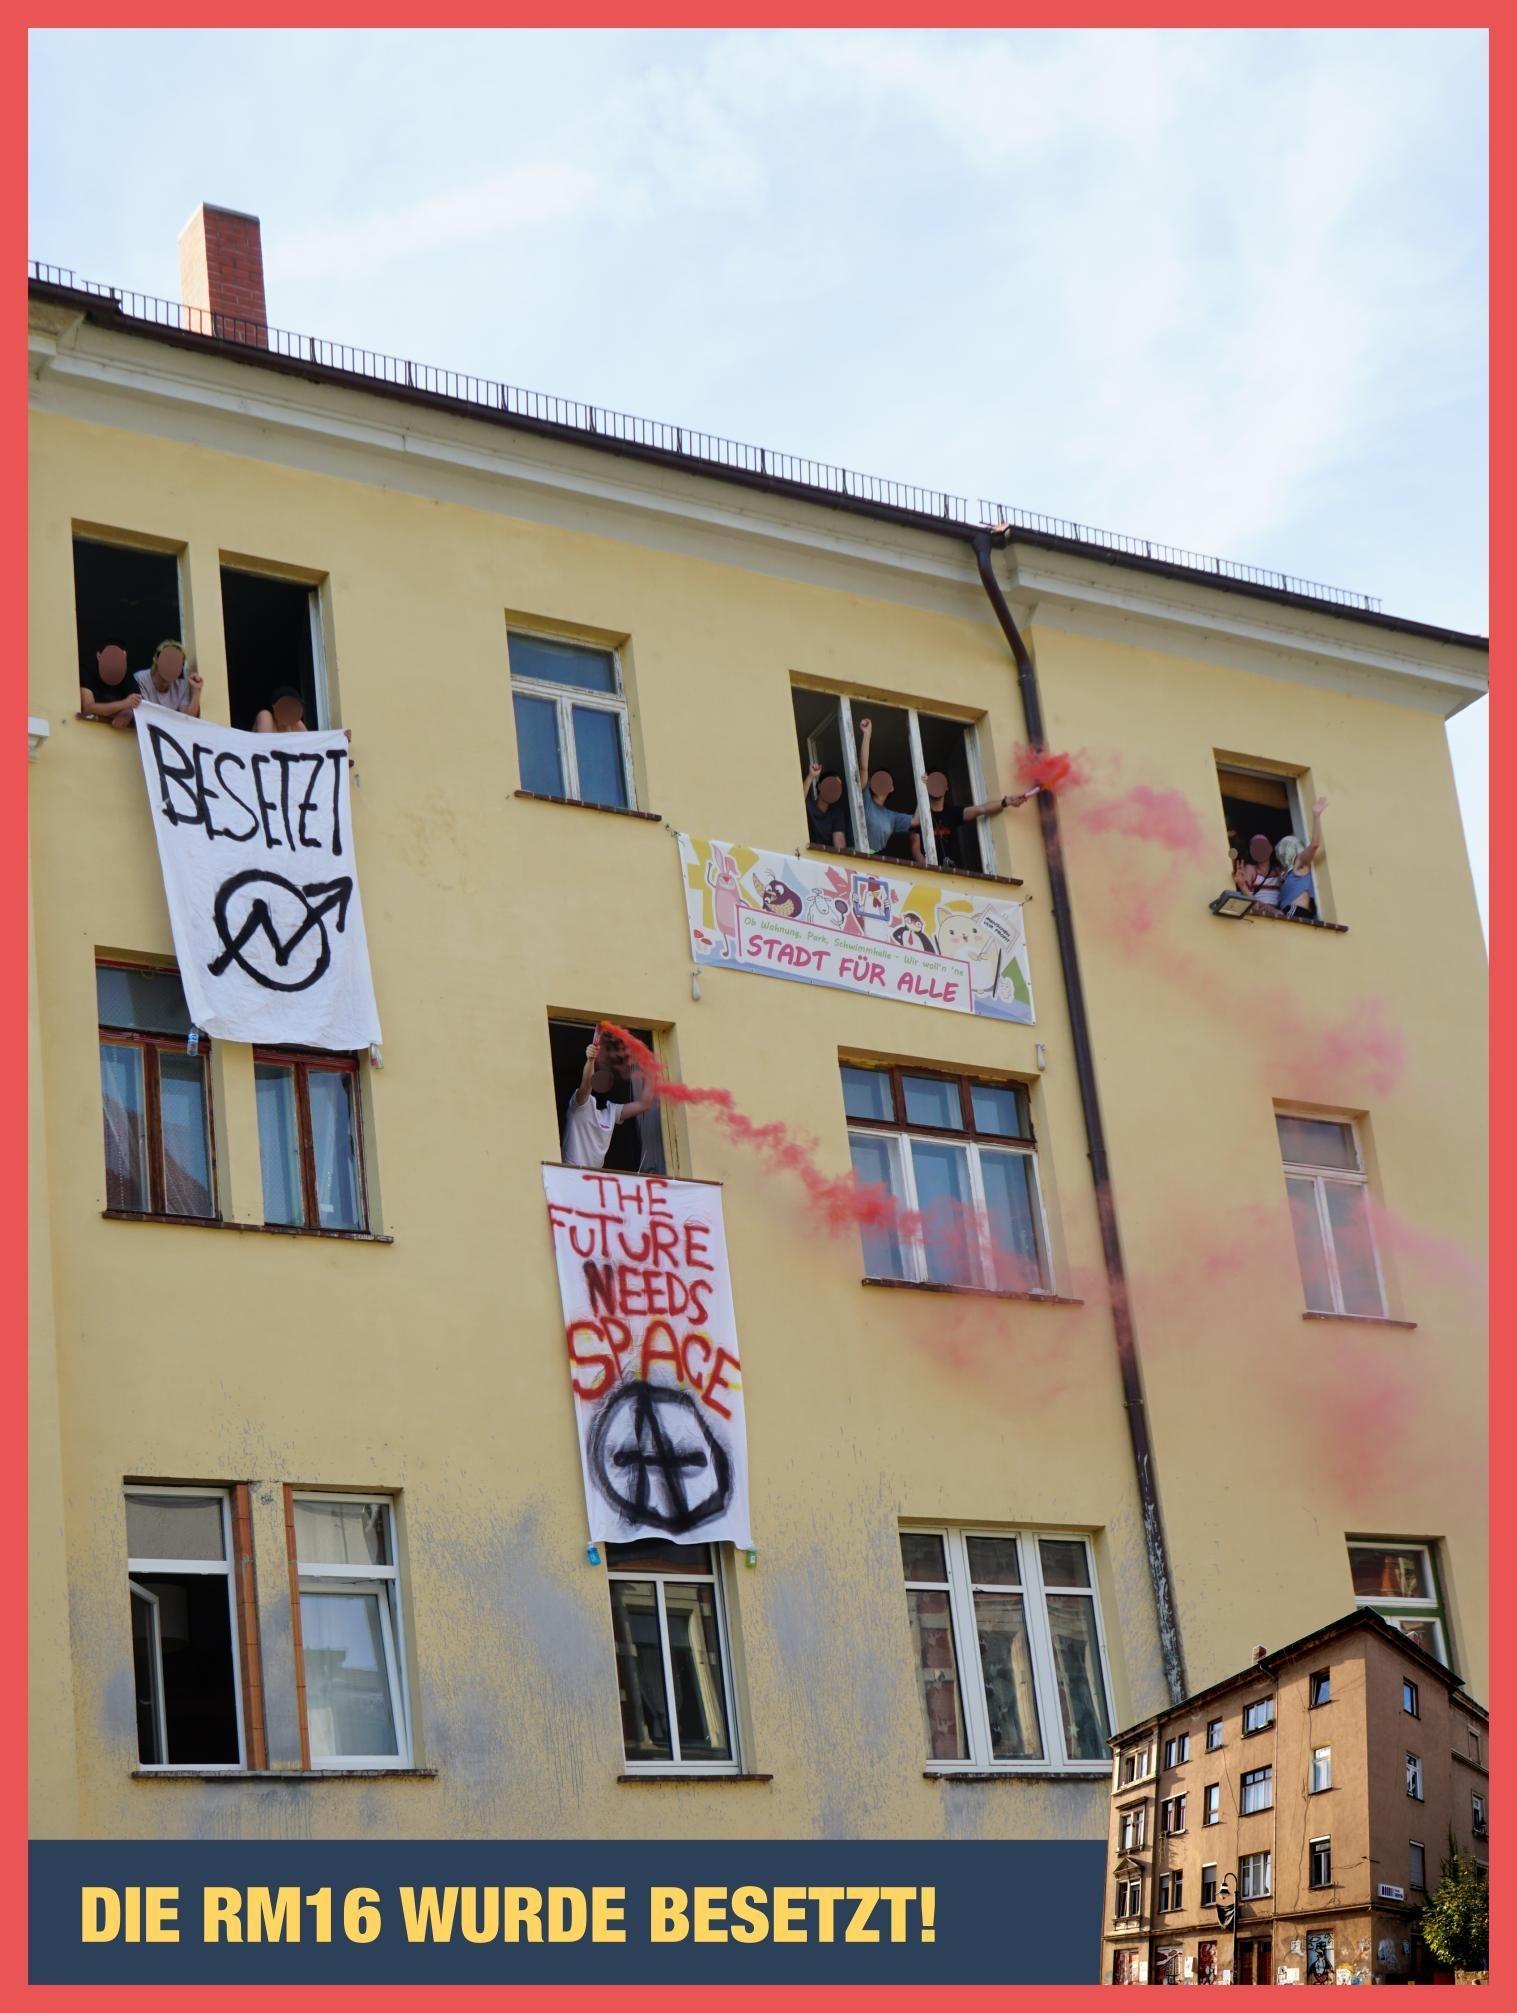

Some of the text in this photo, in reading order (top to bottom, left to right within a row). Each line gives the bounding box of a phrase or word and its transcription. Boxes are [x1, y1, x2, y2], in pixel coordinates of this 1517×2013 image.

[147, 723, 348, 857] BESETZT
[744, 916, 757, 927] Ob
[761, 921, 802, 939] Wohnung,
[807, 931, 829, 945] Park,
[833, 938, 892, 960] Schwimmhalle
[904, 954, 920, 966] Wir
[747, 934, 959, 1003] STADT FÜR ALLE
[582, 1172, 673, 1220] THE
[548, 1202, 715, 1272] FUTURE
[583, 1258, 713, 1326] NEEDS
[565, 1313, 742, 1421] SPACE
